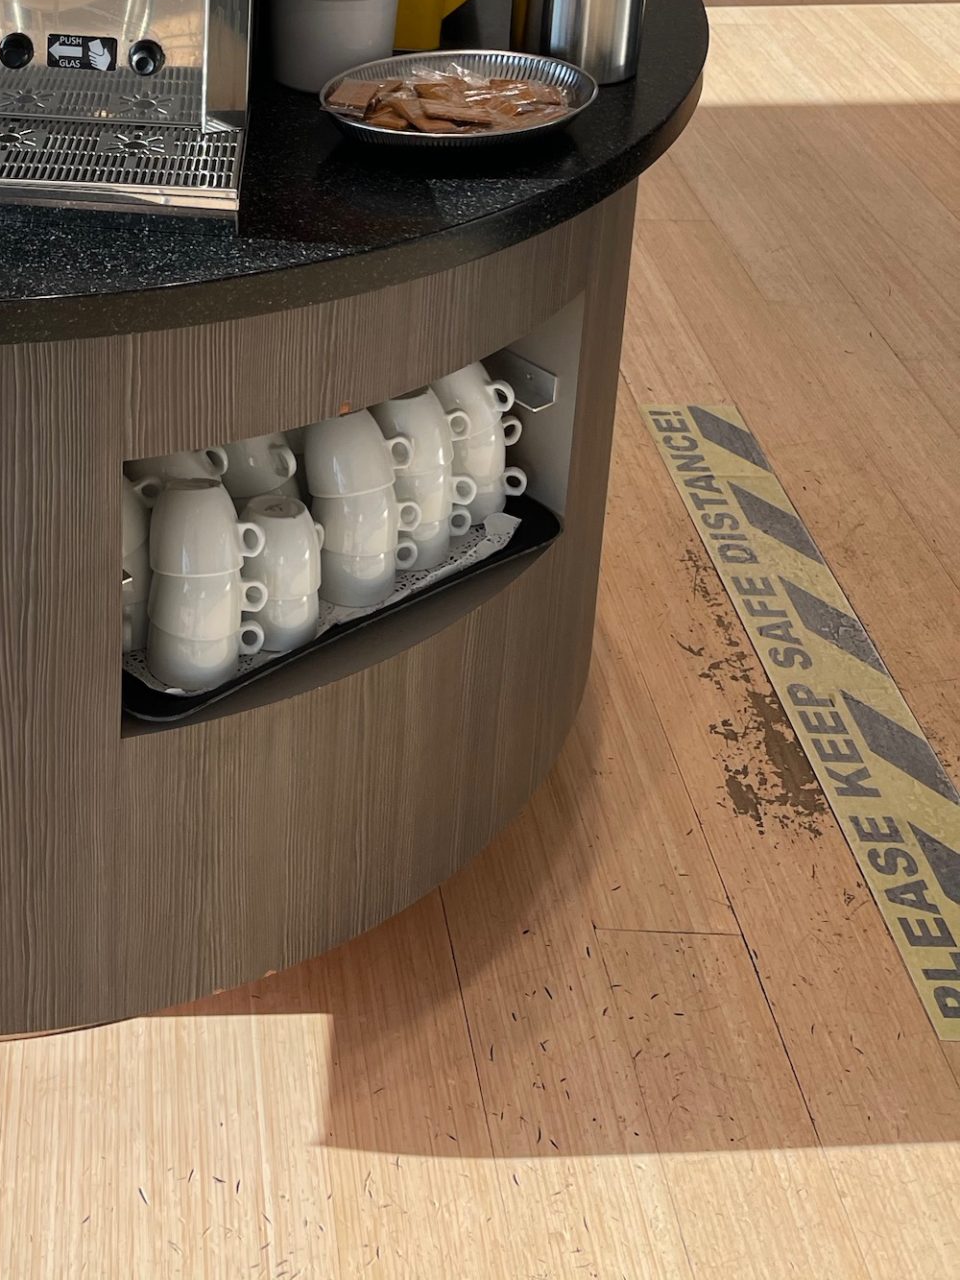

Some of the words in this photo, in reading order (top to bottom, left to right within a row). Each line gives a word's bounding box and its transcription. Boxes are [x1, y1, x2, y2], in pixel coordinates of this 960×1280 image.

[59, 36, 82, 45] PUSH
[59, 59, 80, 68] GLAS
[648, 410, 760, 564] DISTANCE!
[731, 575, 813, 670] SAFE
[786, 683, 882, 798] KEEP
